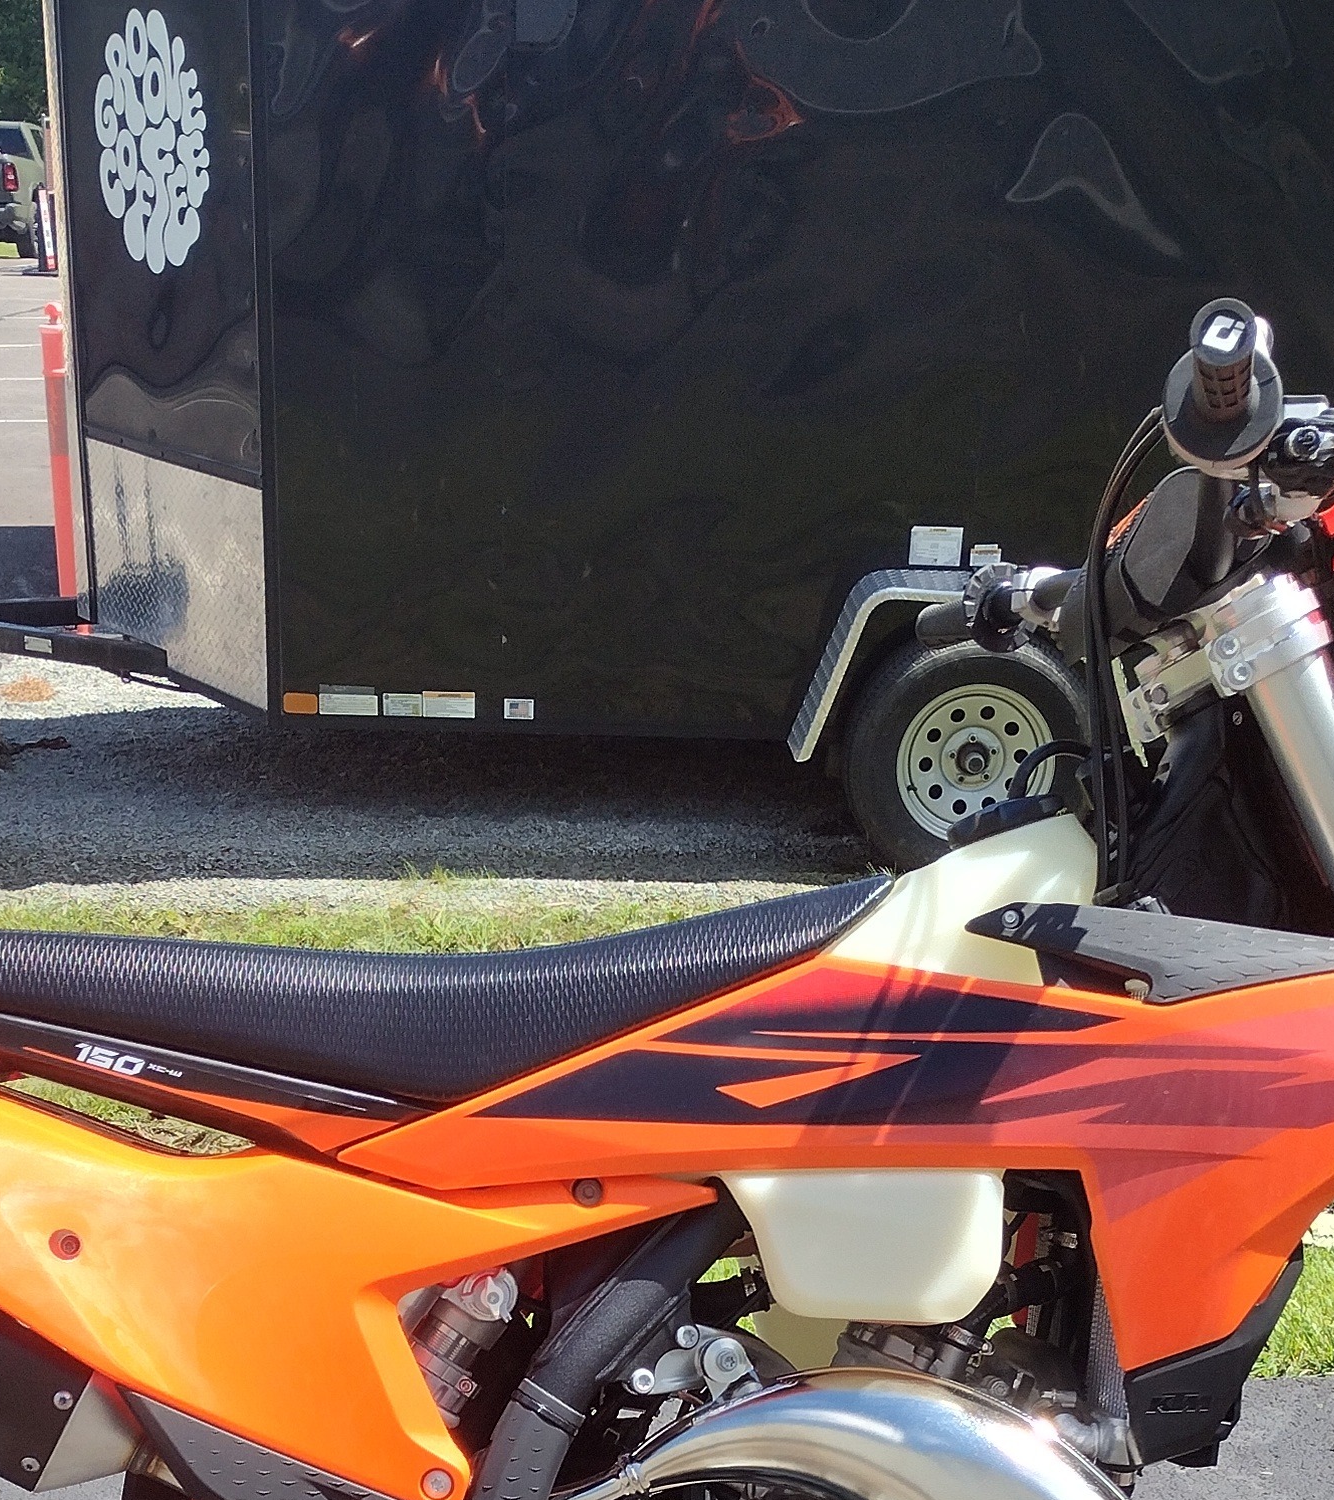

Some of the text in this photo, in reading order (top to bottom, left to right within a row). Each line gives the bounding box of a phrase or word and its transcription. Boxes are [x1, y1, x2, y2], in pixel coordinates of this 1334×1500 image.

[94, 8, 207, 148] GROOVE
[99, 117, 210, 274] COFFEE
[74, 1042, 146, 1076] 150
